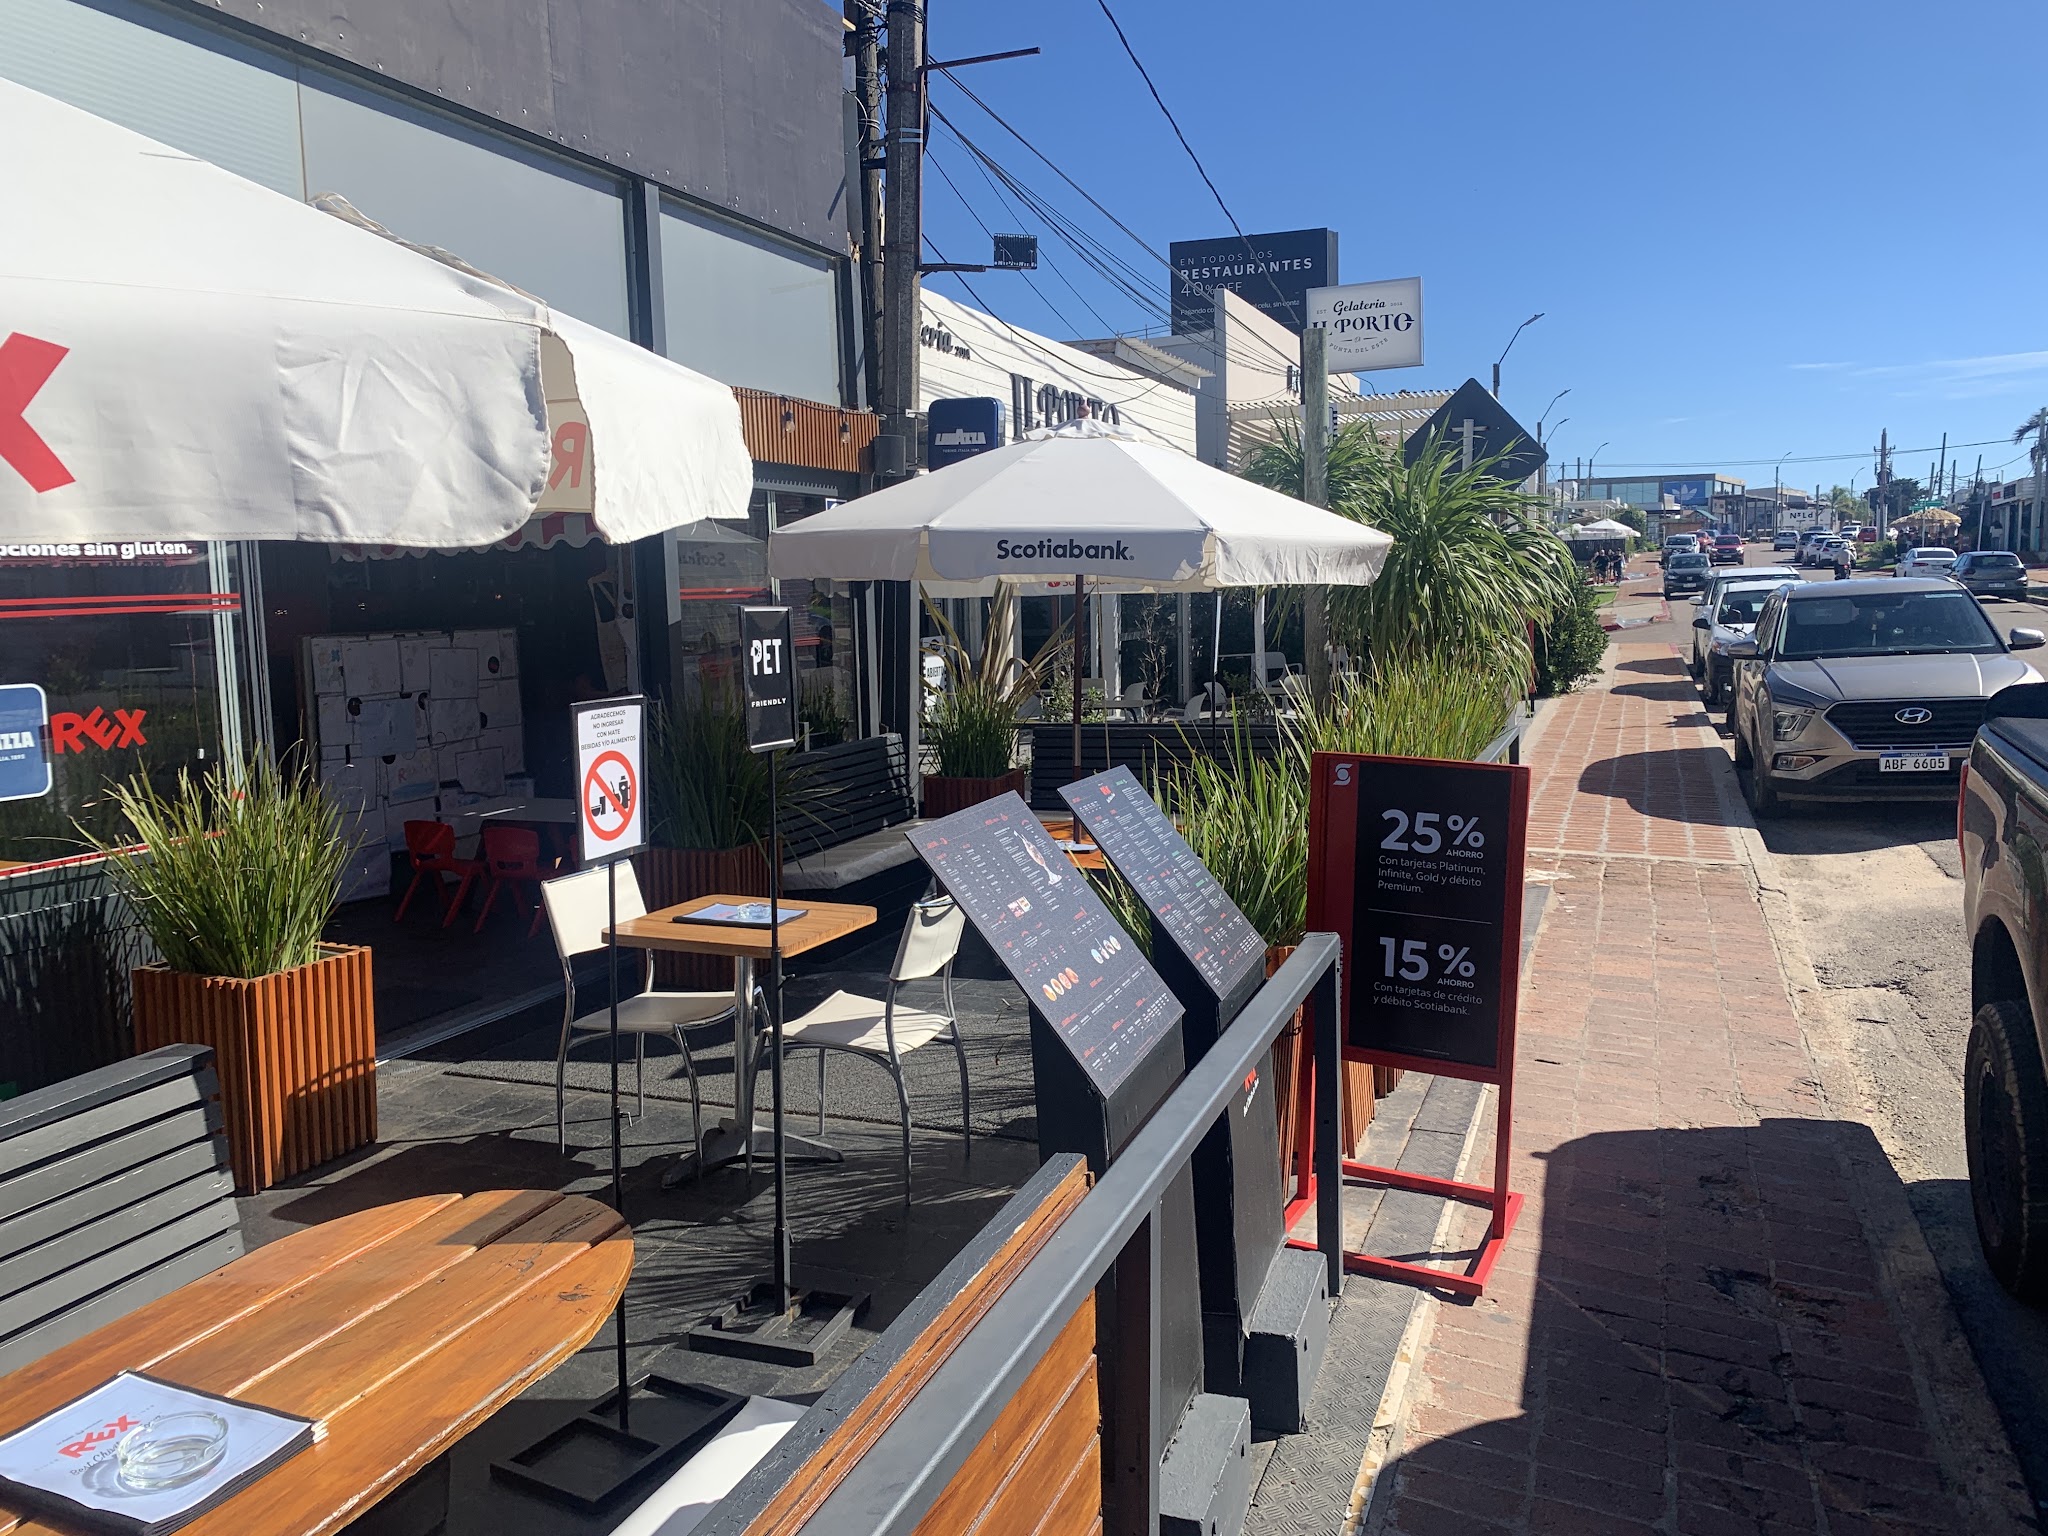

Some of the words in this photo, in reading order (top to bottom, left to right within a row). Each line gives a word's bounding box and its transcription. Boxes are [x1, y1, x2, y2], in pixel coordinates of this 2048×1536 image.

[1181, 258, 1194, 266] EN
[1202, 253, 1243, 264] TODOS
[1250, 250, 1273, 260] LOS
[1180, 257, 1313, 280] RESTAURANTES
[1333, 299, 1386, 316] Gelateria
[1334, 312, 1415, 334] PORTO
[1328, 342, 1352, 354] PUNTA
[1355, 346, 1369, 354] DEL
[1371, 337, 1389, 350] ESTE
[84, 541, 118, 556] sin
[120, 541, 193, 559] gluten.
[750, 639, 782, 676] PET
[751, 697, 787, 708] FRIENDLY
[590, 710, 626, 720] AGRADECEMOS
[601, 719, 624, 728] INGRESAR
[50, 706, 147, 754] REX
[581, 742, 601, 751] BEBIDAS
[611, 735, 637, 745] ALIMENTOS
[1884, 758, 1907, 770] ABF
[1913, 758, 1945, 769] 6605
[1445, 849, 1484, 860] AHORRO
[1378, 855, 1398, 866] Con
[1400, 857, 1438, 871] tarjetas
[1439, 861, 1486, 876] Platinum,
[1378, 867, 1414, 881] Infinite,
[1416, 871, 1439, 883] Gold
[1441, 877, 1448, 885] y
[1449, 875, 1482, 887] débito
[1377, 880, 1424, 893] Premium.
[1436, 978, 1475, 989] AHORRO
[1373, 981, 1393, 992] Con
[1395, 985, 1431, 998] tarjetas
[1433, 990, 1446, 1000] de
[1447, 992, 1483, 1005] crédito
[1373, 996, 1379, 1005] y
[1380, 994, 1412, 1008] débito
[1413, 999, 1471, 1016] Scotiabank.
[57, 1414, 141, 1459] REX
